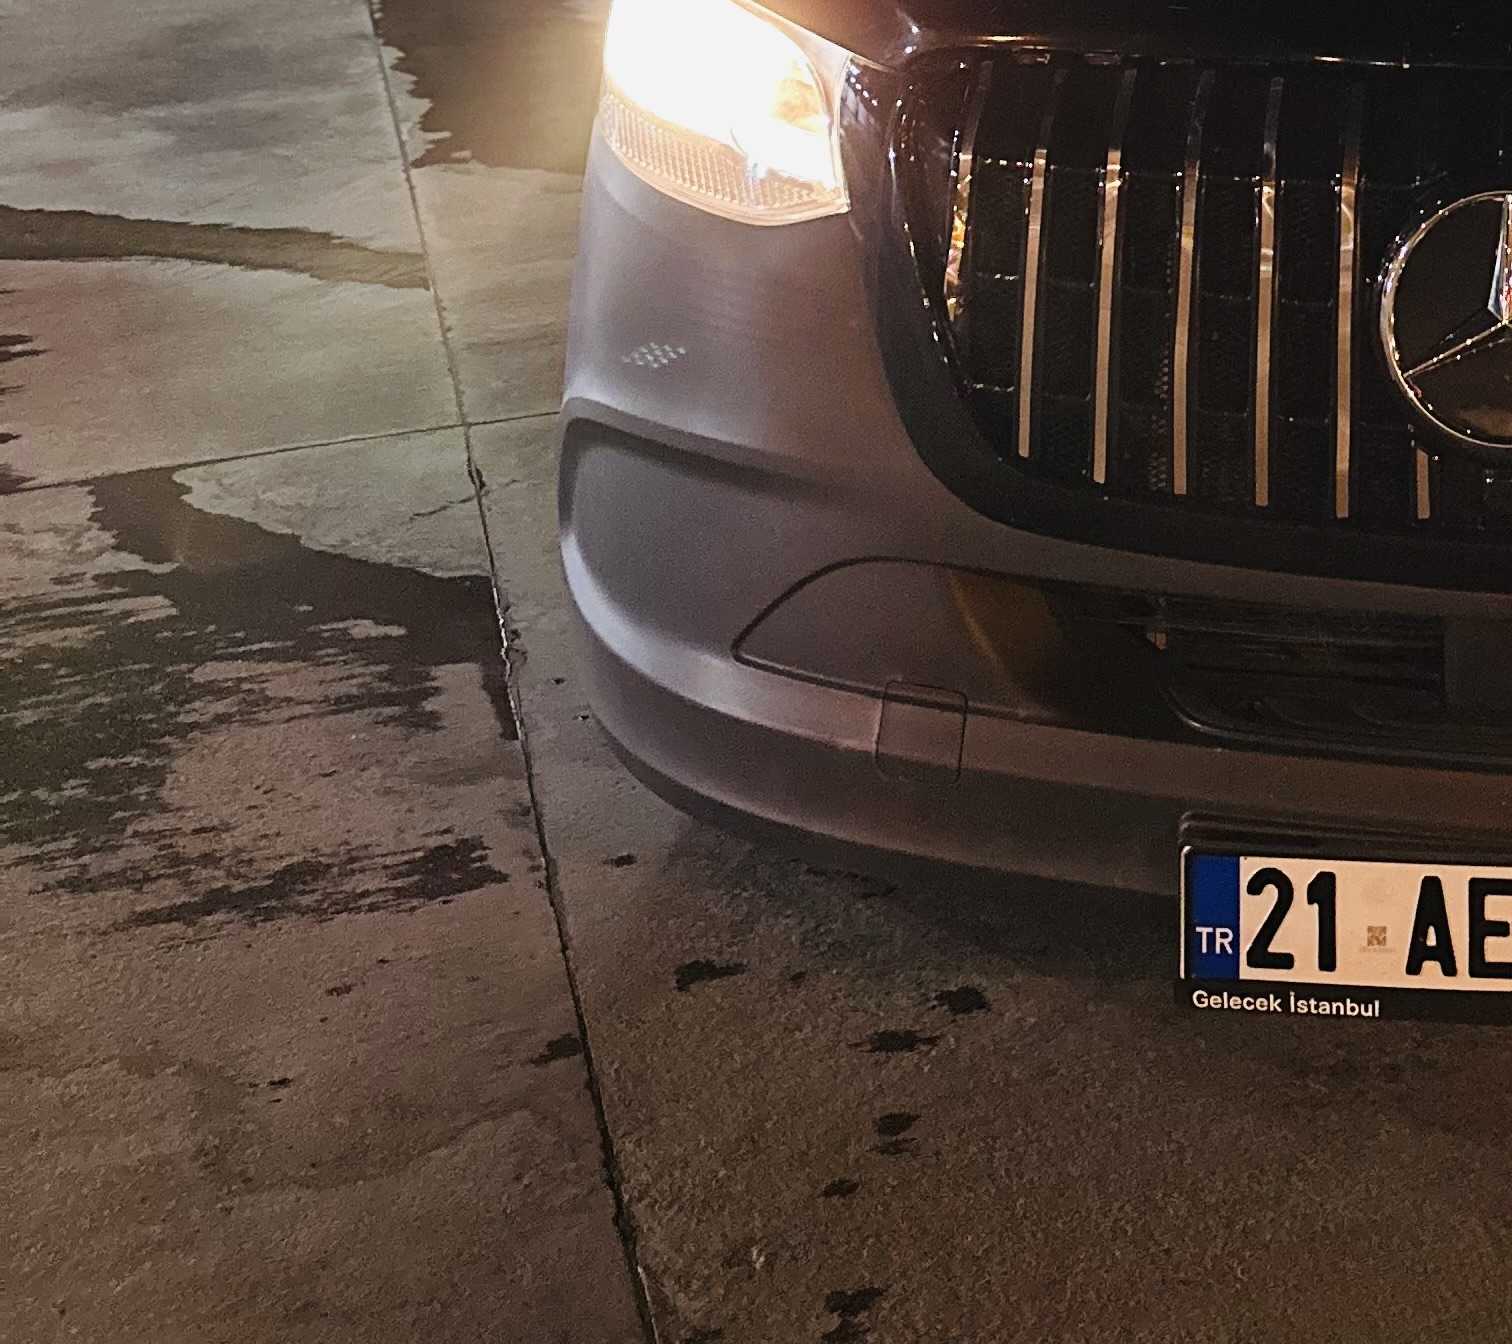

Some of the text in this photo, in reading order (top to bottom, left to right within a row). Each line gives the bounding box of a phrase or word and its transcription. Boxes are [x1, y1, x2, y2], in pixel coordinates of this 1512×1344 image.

[1195, 926, 1234, 957] TR
[1244, 866, 1338, 973] 21
[1192, 989, 1282, 1013] Gelecek
